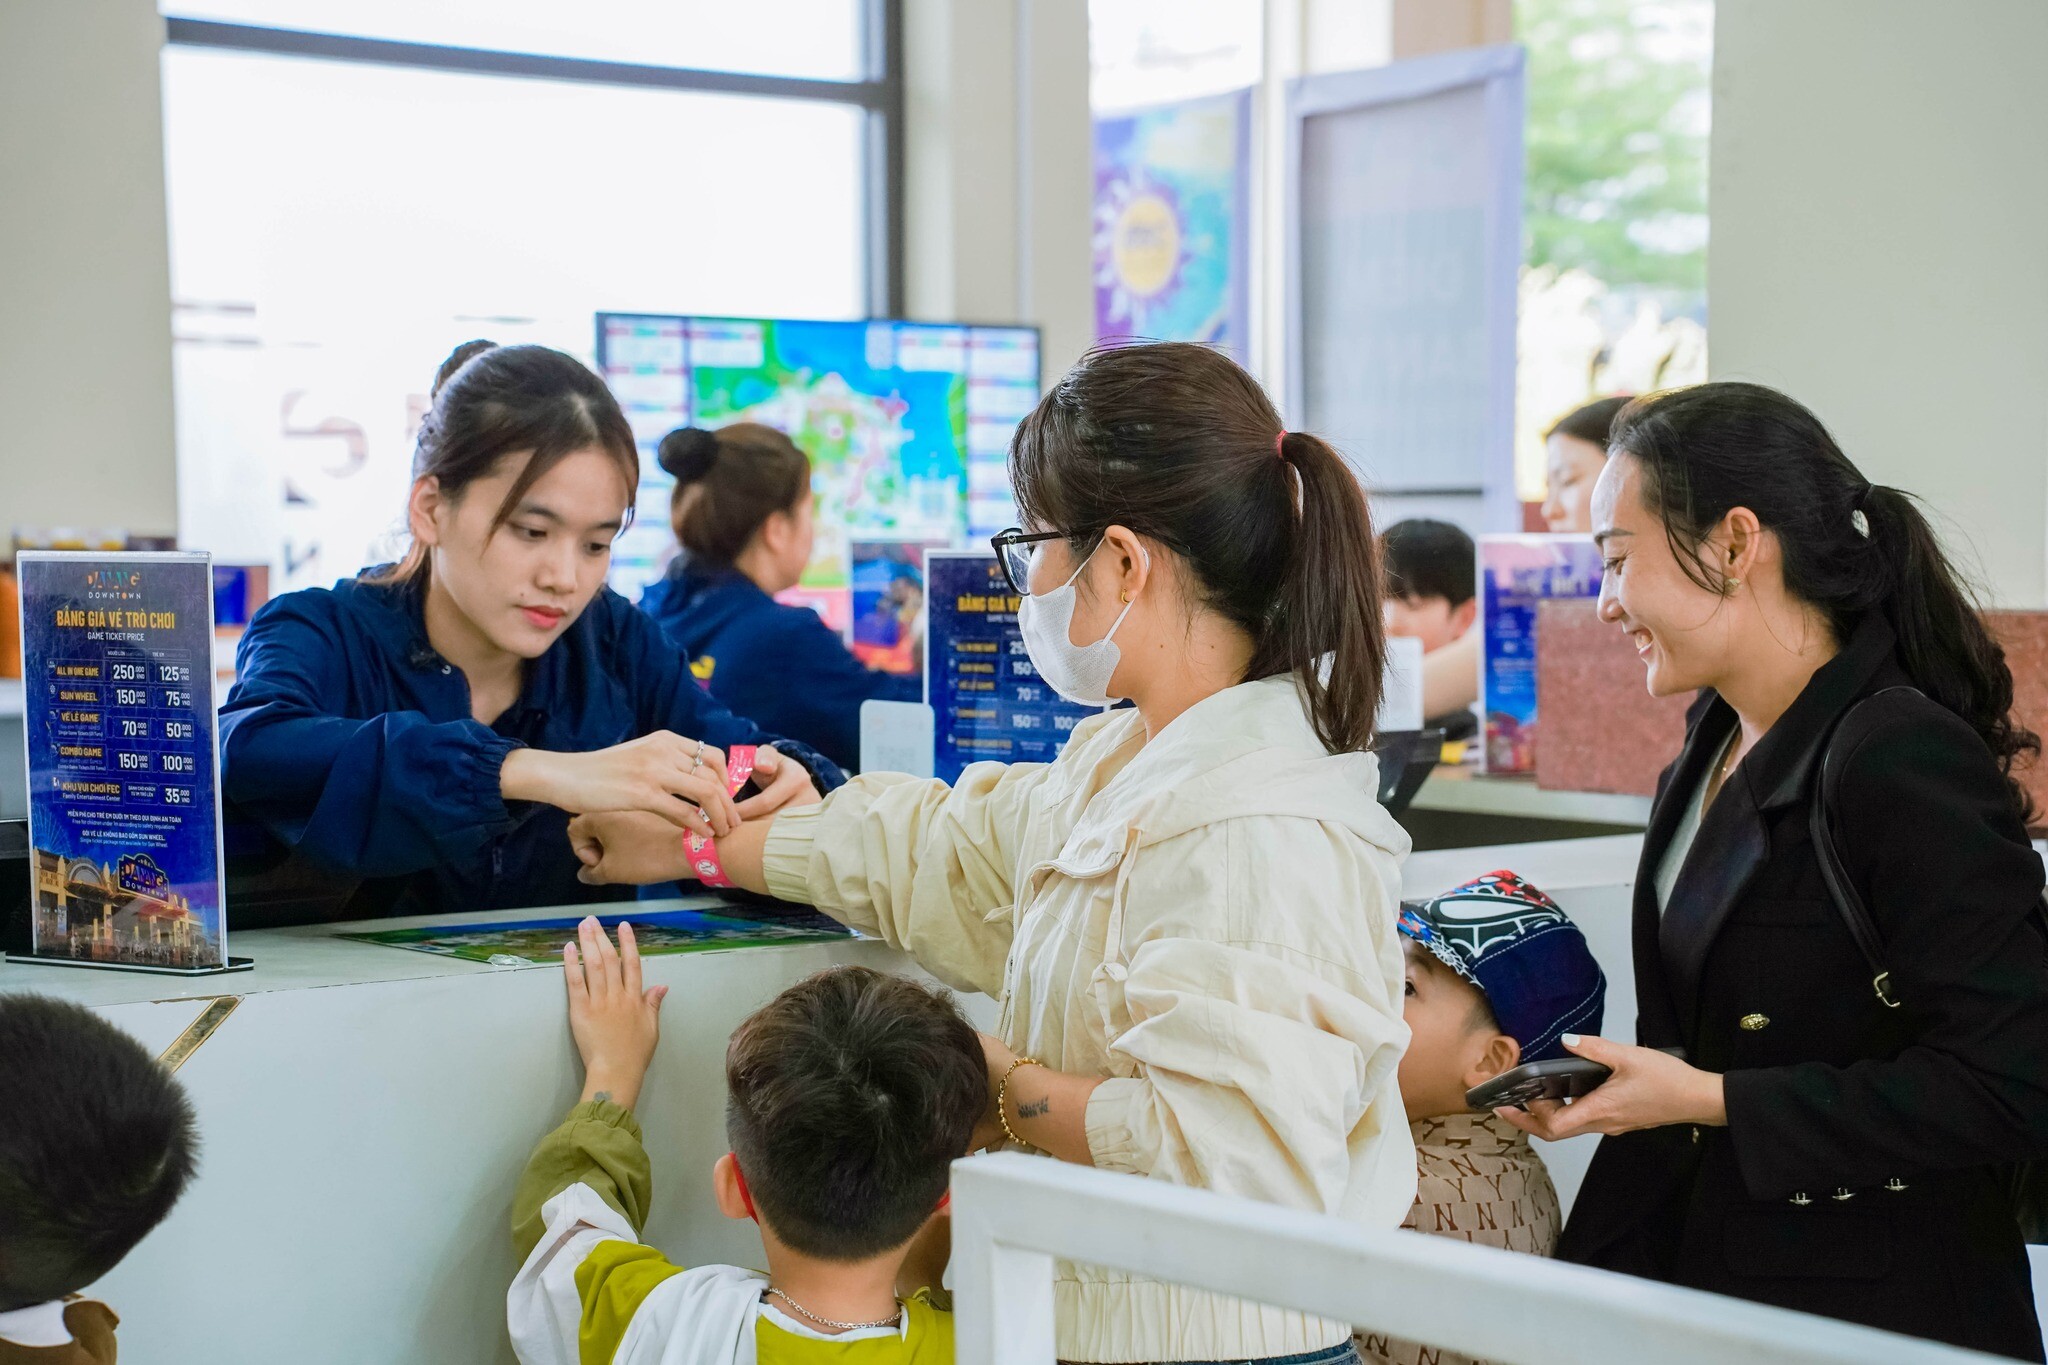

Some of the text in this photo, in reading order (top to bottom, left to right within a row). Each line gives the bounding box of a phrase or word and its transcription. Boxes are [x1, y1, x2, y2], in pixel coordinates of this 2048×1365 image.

[56, 605, 175, 629] BẢNG GIÁ VÉ TRÒ CHƠI
[87, 632, 145, 641] GAME TICKET PRICE
[57, 666, 99, 677] ALL IN ONE GAME
[113, 664, 135, 680] 250
[160, 666, 179, 682] 125
[60, 691, 98, 701] SUN WHEEL
[116, 689, 136, 704] 150
[166, 691, 180, 706] 75
[1016, 687, 1031, 701] 70
[80, 713, 99, 723] GAME
[1054, 715, 1073, 730] 100
[122, 721, 136, 736] 70
[166, 722, 181, 738] 50
[60, 746, 102, 757] COMBO GAME
[118, 753, 138, 769] 150
[162, 755, 183, 771] 100
[62, 782, 76, 791] KHU
[76, 781, 89, 793] VUI
[107, 784, 120, 794] FEC
[63, 792, 76, 800] Family
[77, 793, 106, 801] Entertainment
[165, 788, 180, 803] 35
[1434, 1202, 1459, 1231] N
[1476, 1202, 1498, 1230] N
